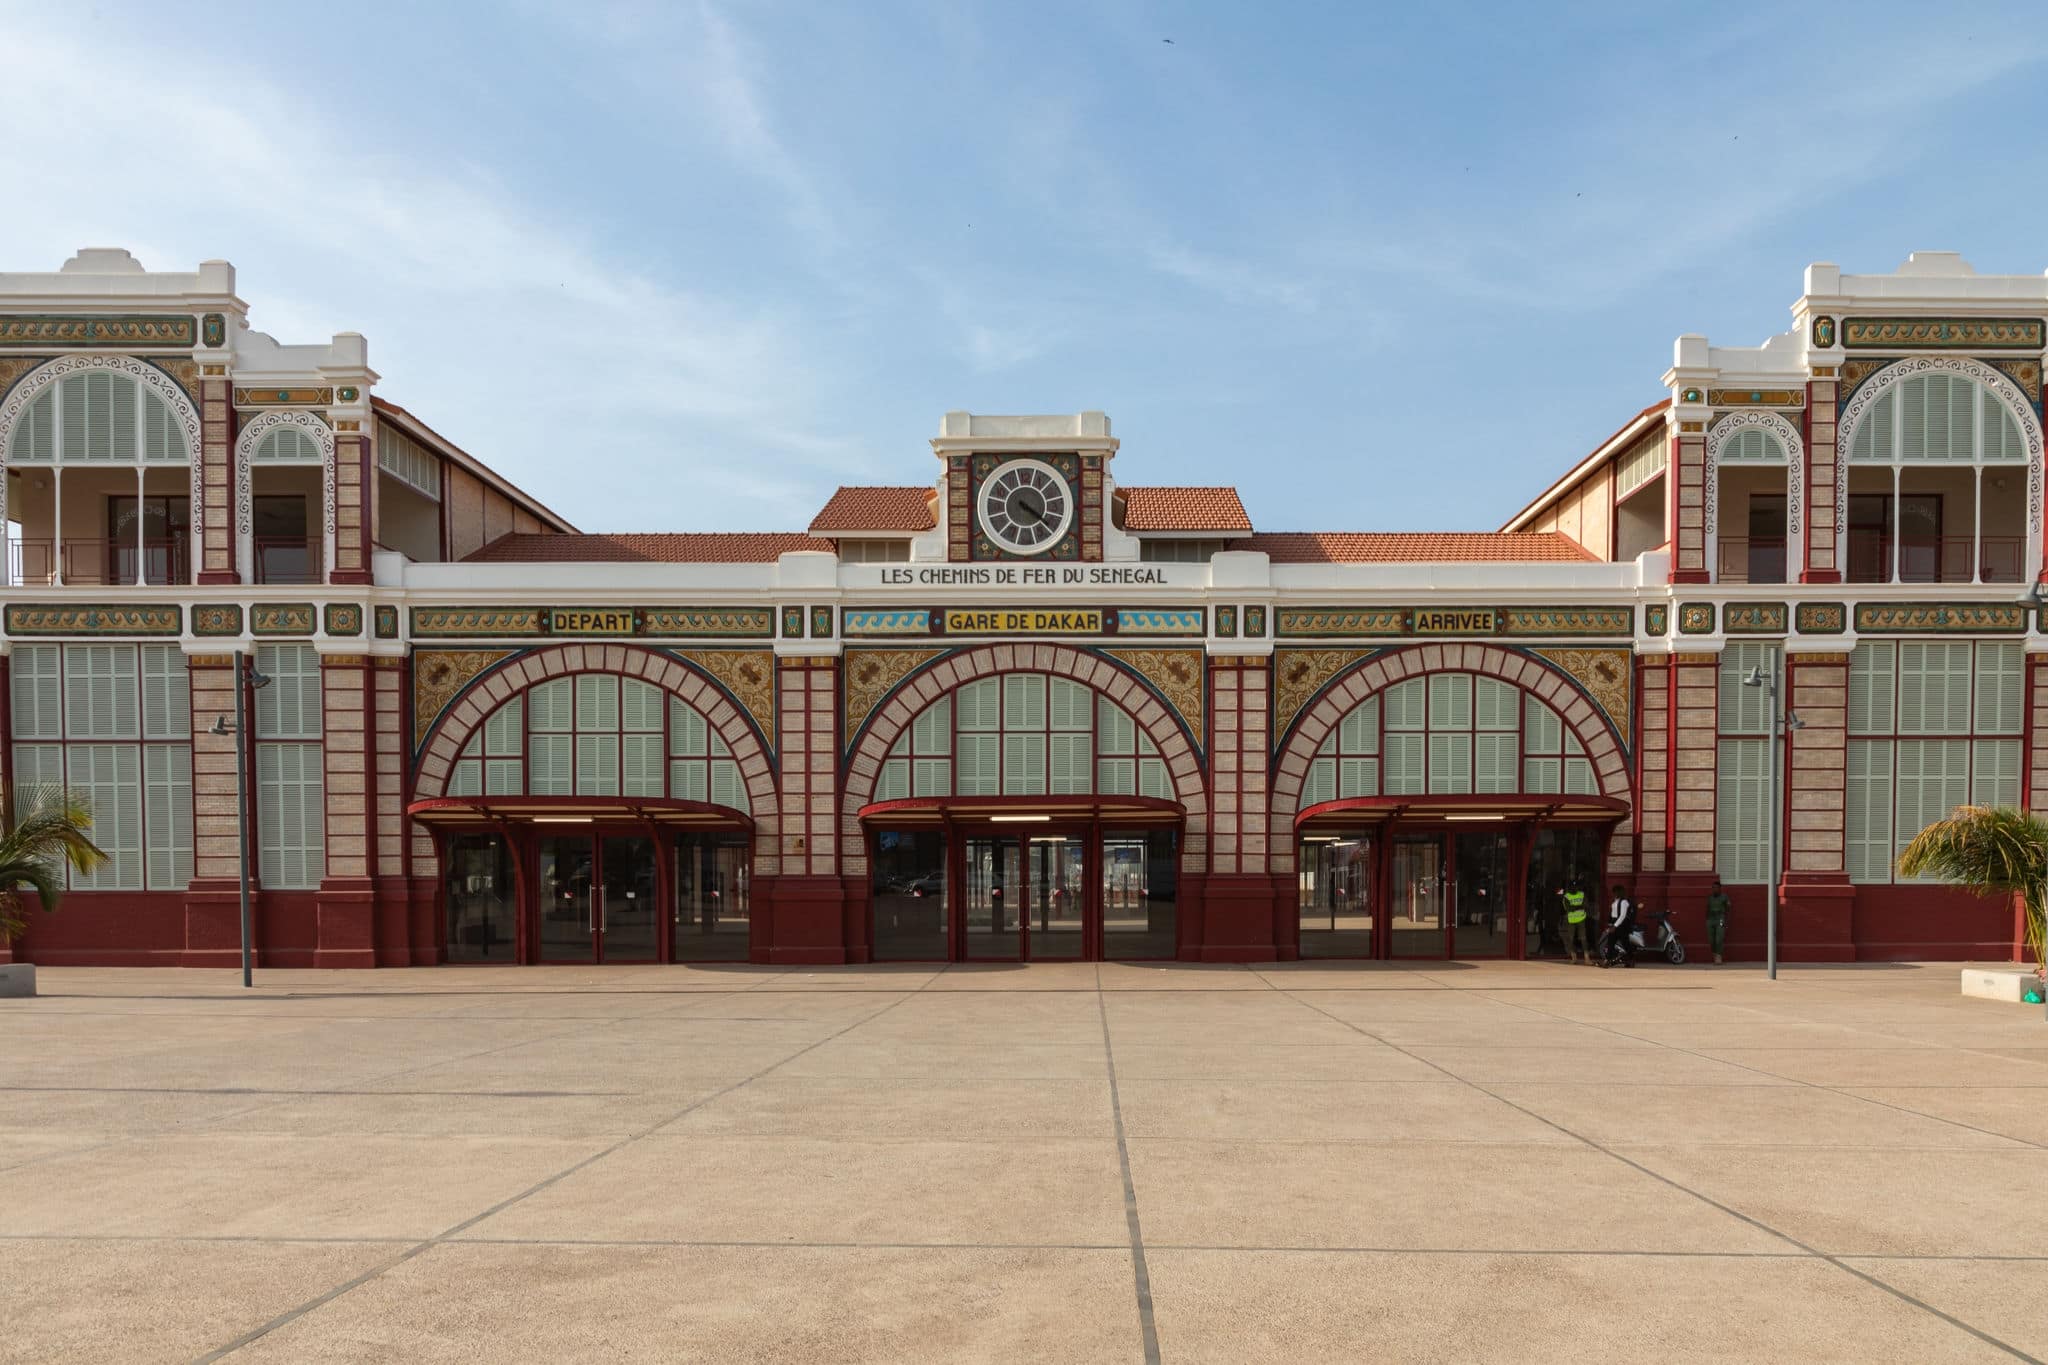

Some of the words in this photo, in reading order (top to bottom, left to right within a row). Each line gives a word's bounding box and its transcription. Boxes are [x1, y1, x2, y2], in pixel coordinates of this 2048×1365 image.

[881, 568, 913, 584] LES
[919, 568, 990, 584] CHEMINS
[996, 568, 1017, 584] DE
[1023, 568, 1056, 584] FER
[1063, 568, 1084, 584] DU
[1089, 568, 1168, 584] SENEGAL
[554, 613, 631, 631] DEPART
[950, 614, 1000, 630] GARE
[1006, 614, 1029, 630] DE
[1035, 614, 1099, 630] DAKAR
[1417, 613, 1492, 630] ARRIVEE
